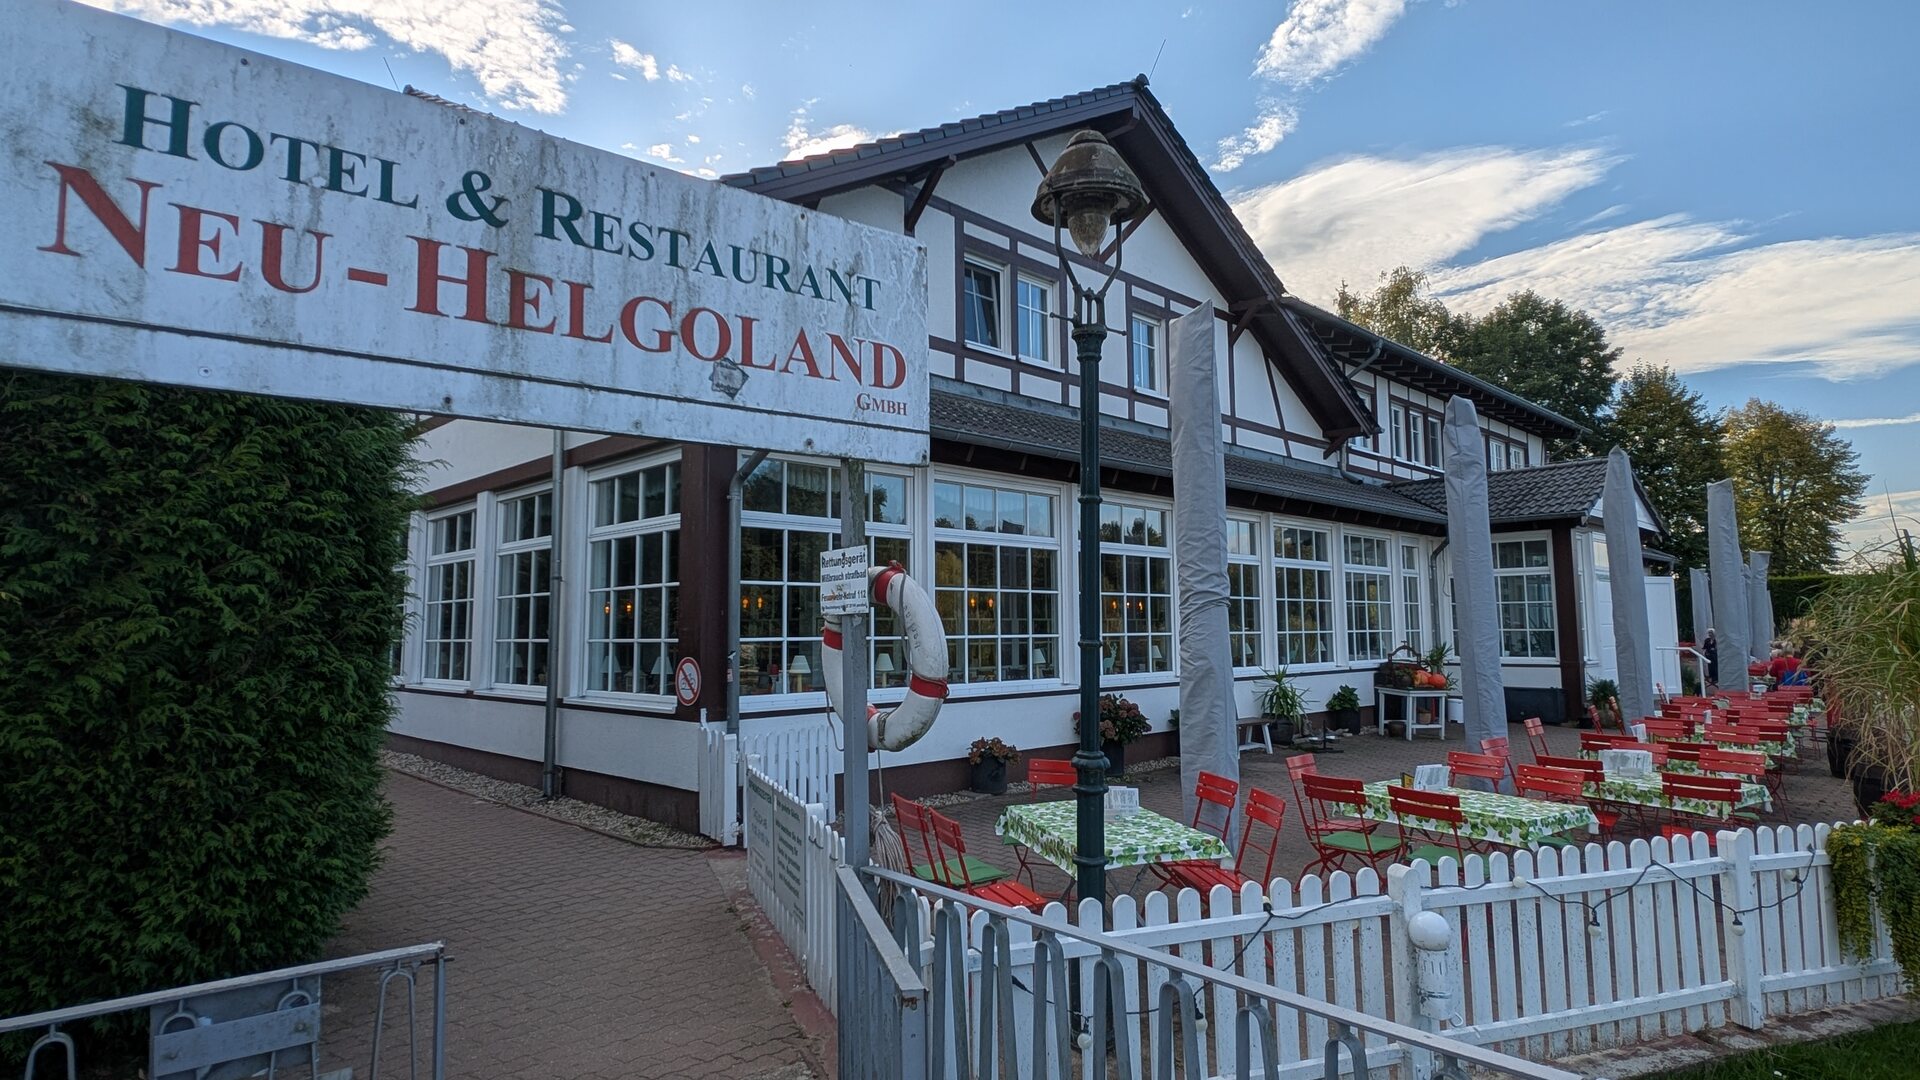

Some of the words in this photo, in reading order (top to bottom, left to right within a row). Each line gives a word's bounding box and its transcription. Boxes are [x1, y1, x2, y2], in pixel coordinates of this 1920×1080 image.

[112, 83, 419, 210] HOTEL
[446, 170, 508, 229] &
[535, 186, 882, 311] RESTAURANT
[822, 552, 866, 568] Rettungsgerät
[822, 590, 856, 601] Feuwehr-Notruf
[857, 589, 866, 599] 112
